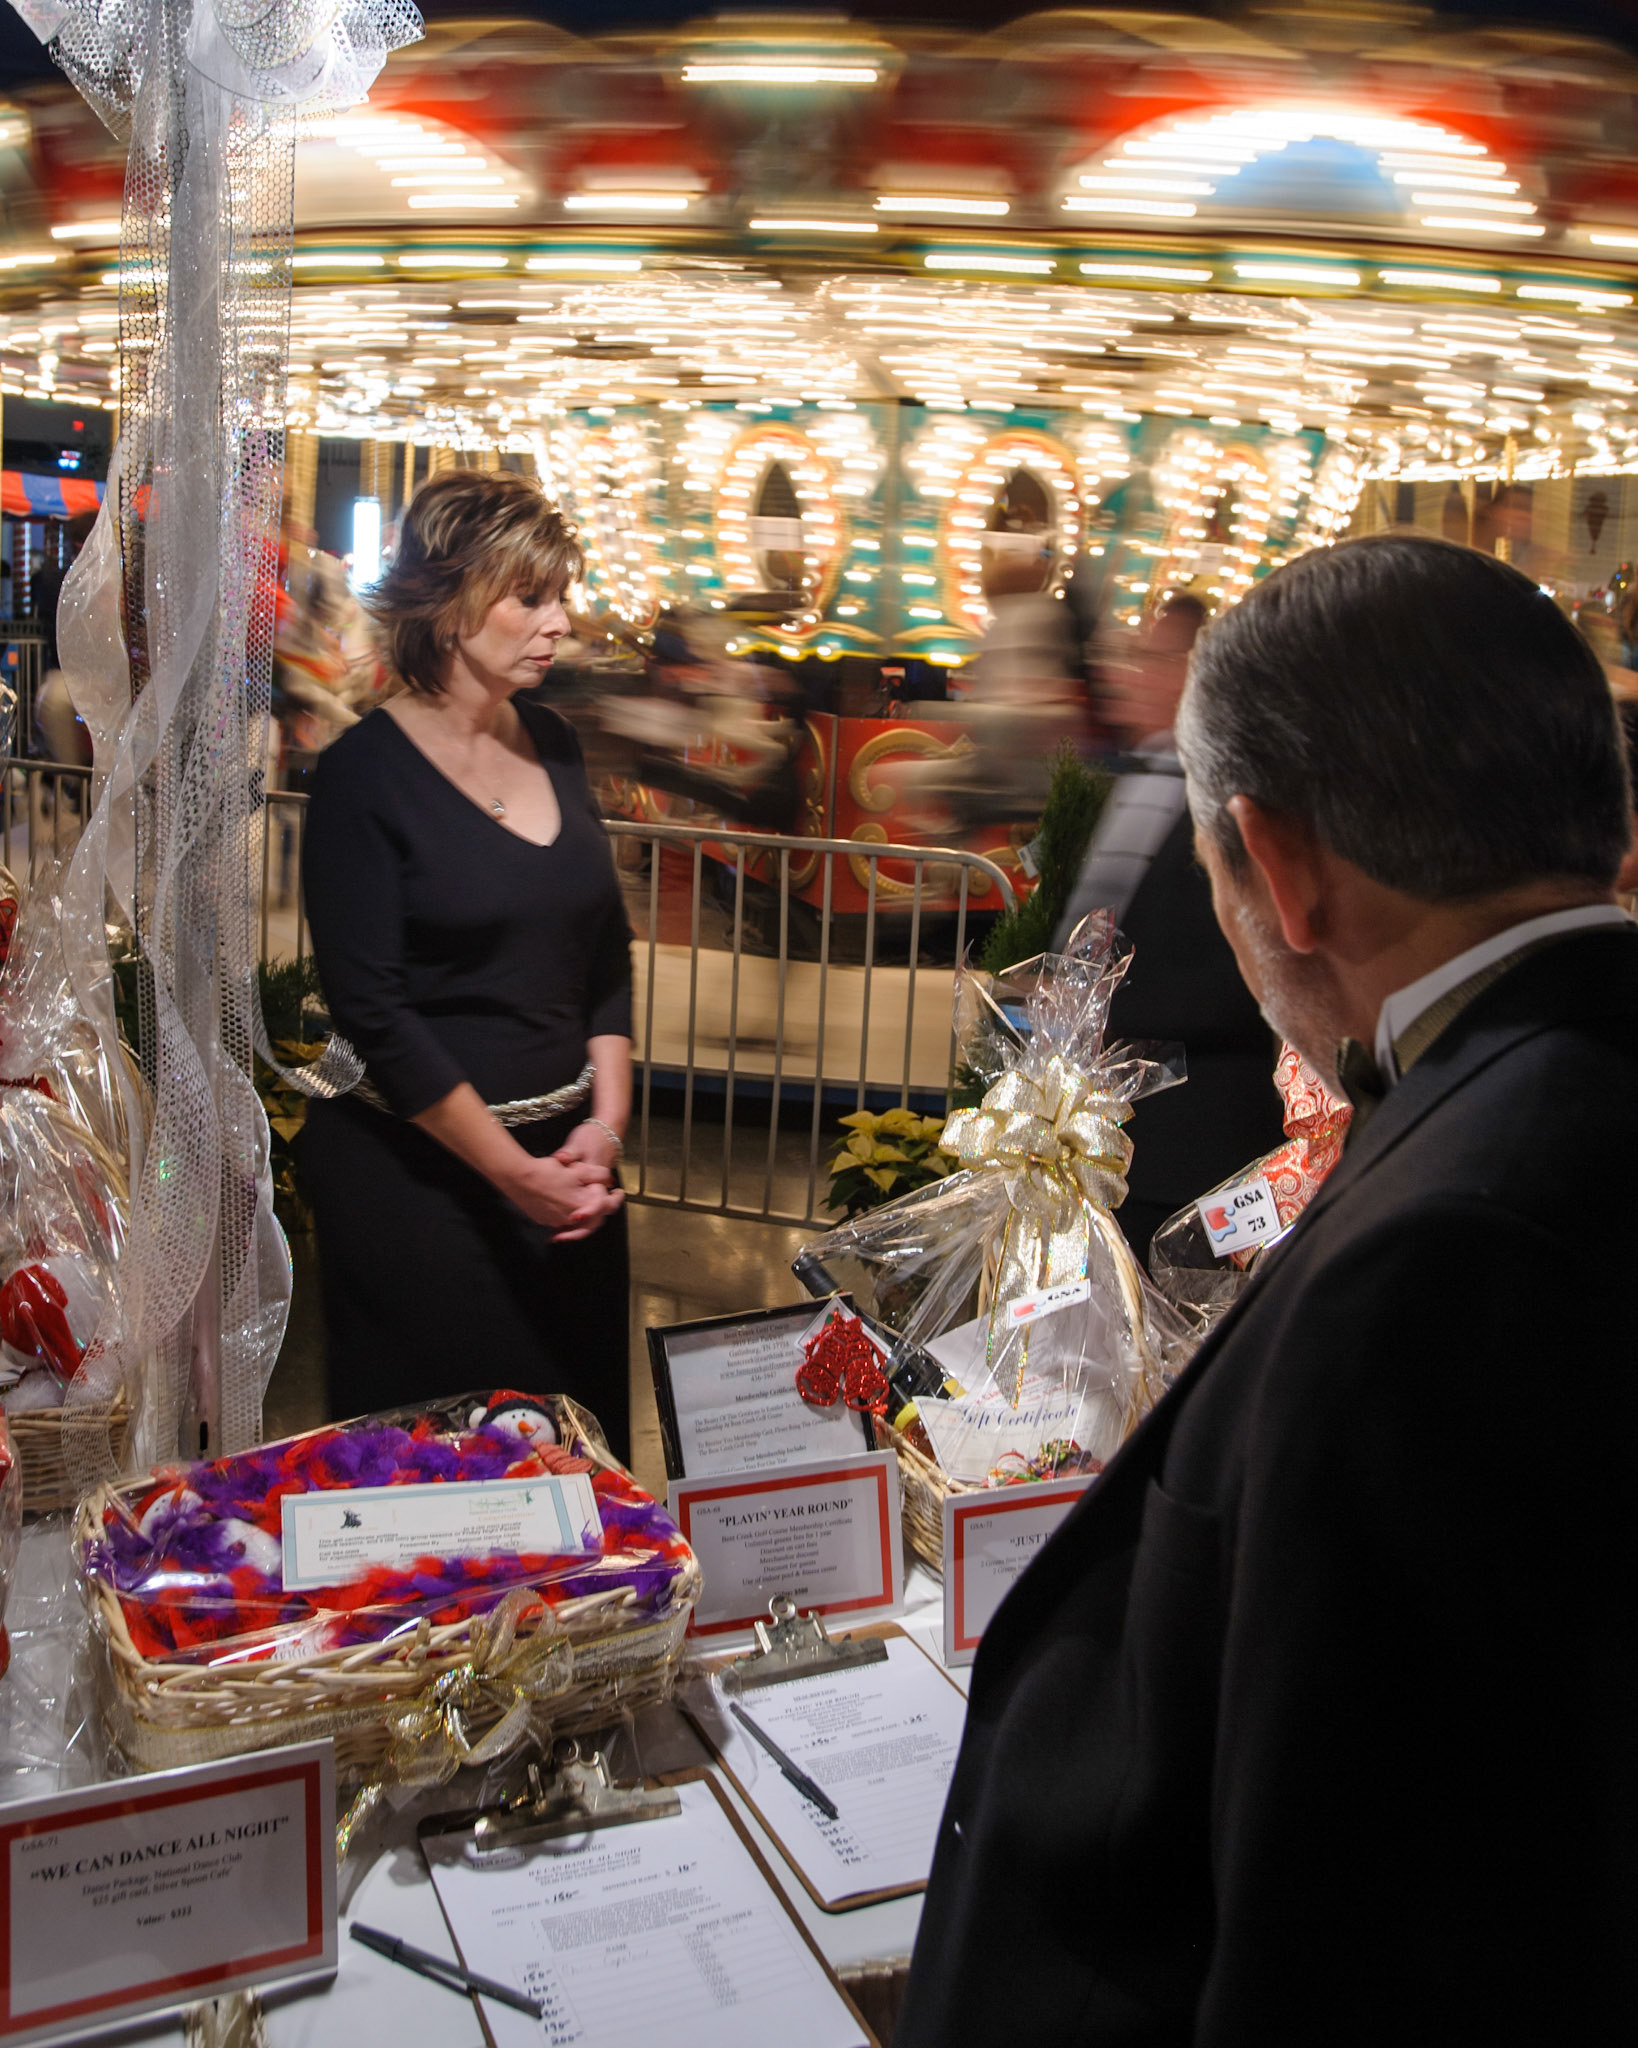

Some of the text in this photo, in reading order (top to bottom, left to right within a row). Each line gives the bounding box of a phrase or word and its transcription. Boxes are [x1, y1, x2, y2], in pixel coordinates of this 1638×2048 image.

[1233, 1190, 1264, 1209] GSA
[1247, 1217, 1267, 1233] 73
[735, 1392, 768, 1402] Membership
[992, 1404, 1078, 1428] Certificate
[756, 1450, 785, 1461] Membership
[719, 1498, 854, 1527] “PLAYIN’ YEAR ROUND”
[736, 1532, 752, 1542] Creek
[754, 1530, 768, 1538] Golf
[769, 1528, 788, 1536] Course
[790, 1522, 824, 1534] Membership
[825, 1518, 852, 1527] Certificate
[400, 1541, 430, 1549] Presented
[744, 1538, 773, 1548] Unlimited
[793, 1534, 807, 1542] fees
[820, 1530, 832, 1538] year
[1009, 1533, 1042, 1548] “JUST
[760, 1546, 787, 1556] Discount
[796, 1542, 806, 1550] cart
[806, 1540, 818, 1548] fees
[795, 1550, 820, 1560] discount
[742, 1577, 754, 1586] Use
[762, 1572, 779, 1582] indoor
[780, 1570, 794, 1581] pool
[820, 1564, 837, 1573] center
[763, 1560, 816, 1574] Discount for guests
[30, 1816, 289, 1882] “WE CAN DANCE ALL NIGHT”
[82, 1883, 110, 1896] Dance
[154, 1864, 191, 1880] National
[193, 1858, 220, 1872] Dance
[222, 1852, 242, 1864] Club
[111, 1889, 127, 1905] gift
[153, 1879, 179, 1892] Silver
[181, 1874, 208, 1888] Spoon
[136, 1913, 165, 1926] Value:
